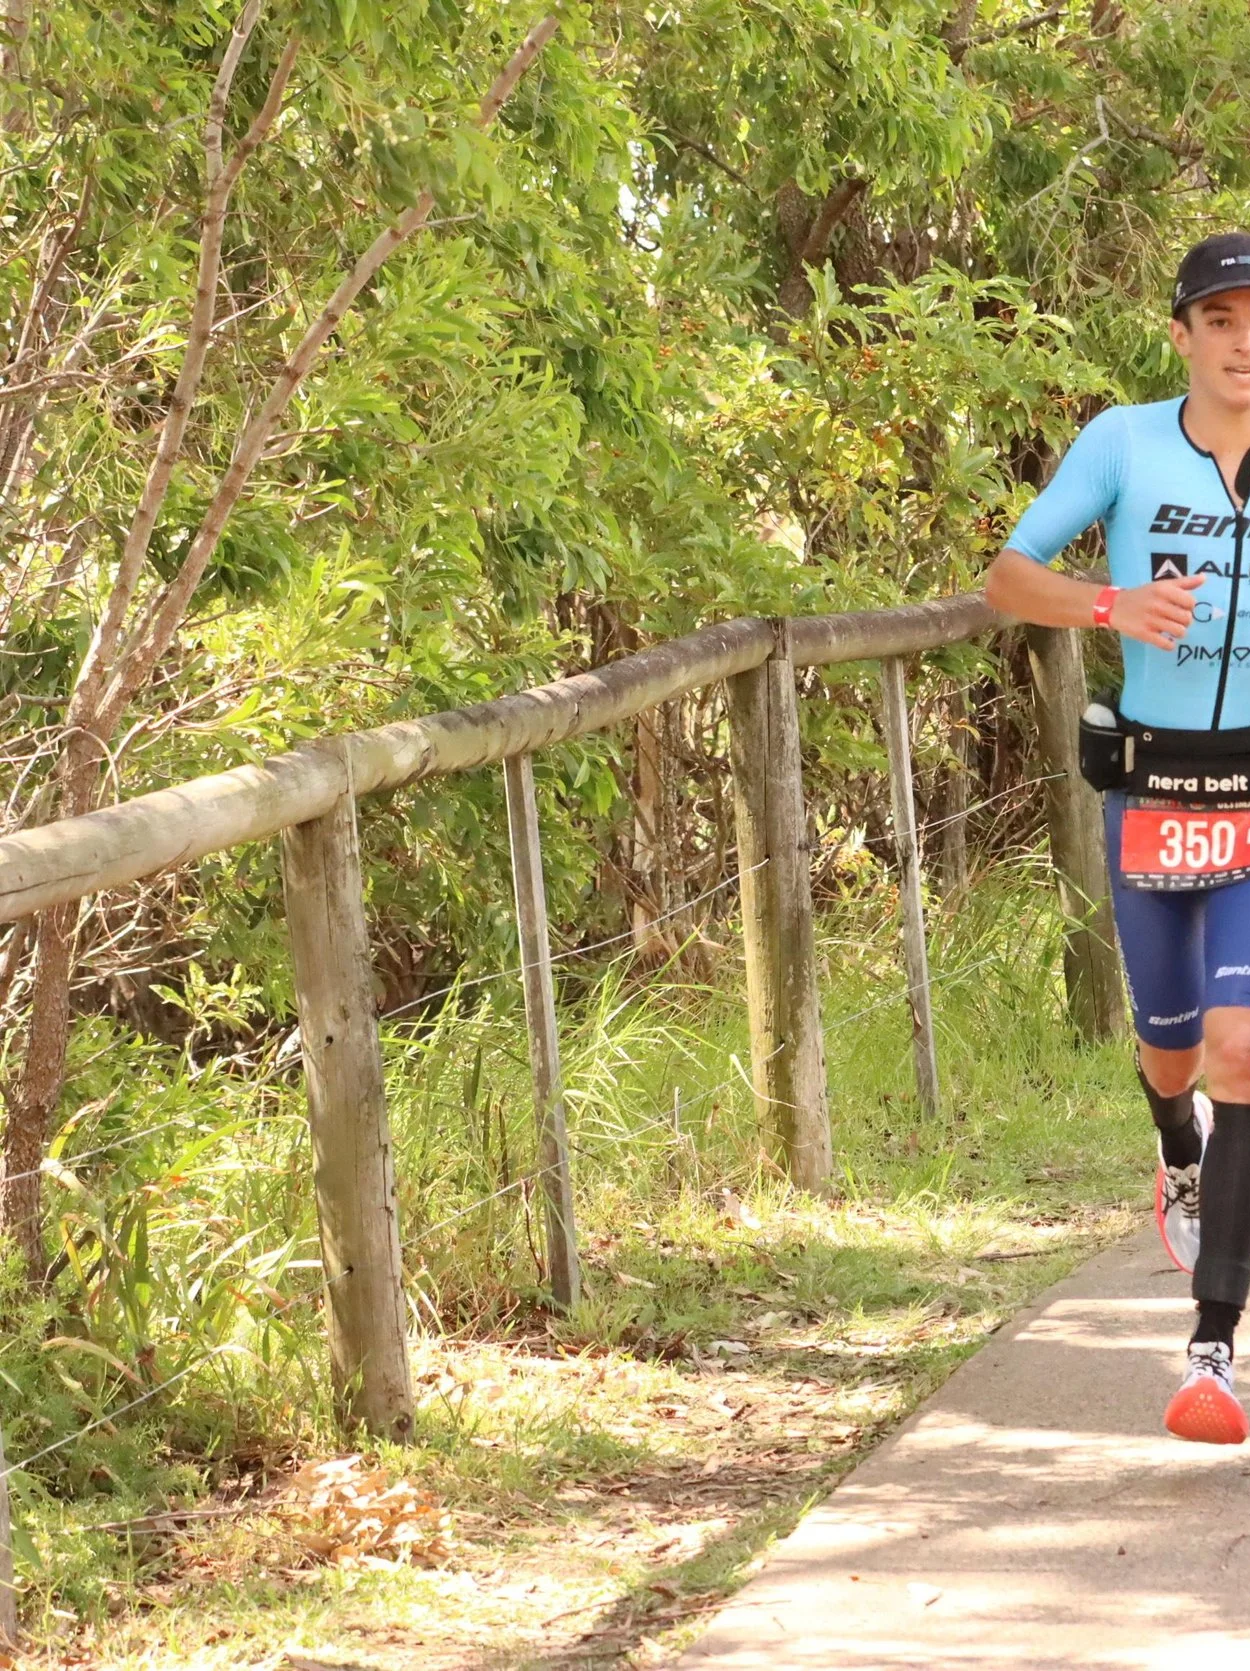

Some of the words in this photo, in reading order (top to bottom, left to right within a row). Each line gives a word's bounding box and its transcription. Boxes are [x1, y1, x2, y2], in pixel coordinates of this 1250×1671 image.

[1148, 774, 1198, 792] nera
[1204, 774, 1248, 792] belt
[1158, 819, 1236, 868] 350
[1148, 1006, 1200, 1026] Santini
